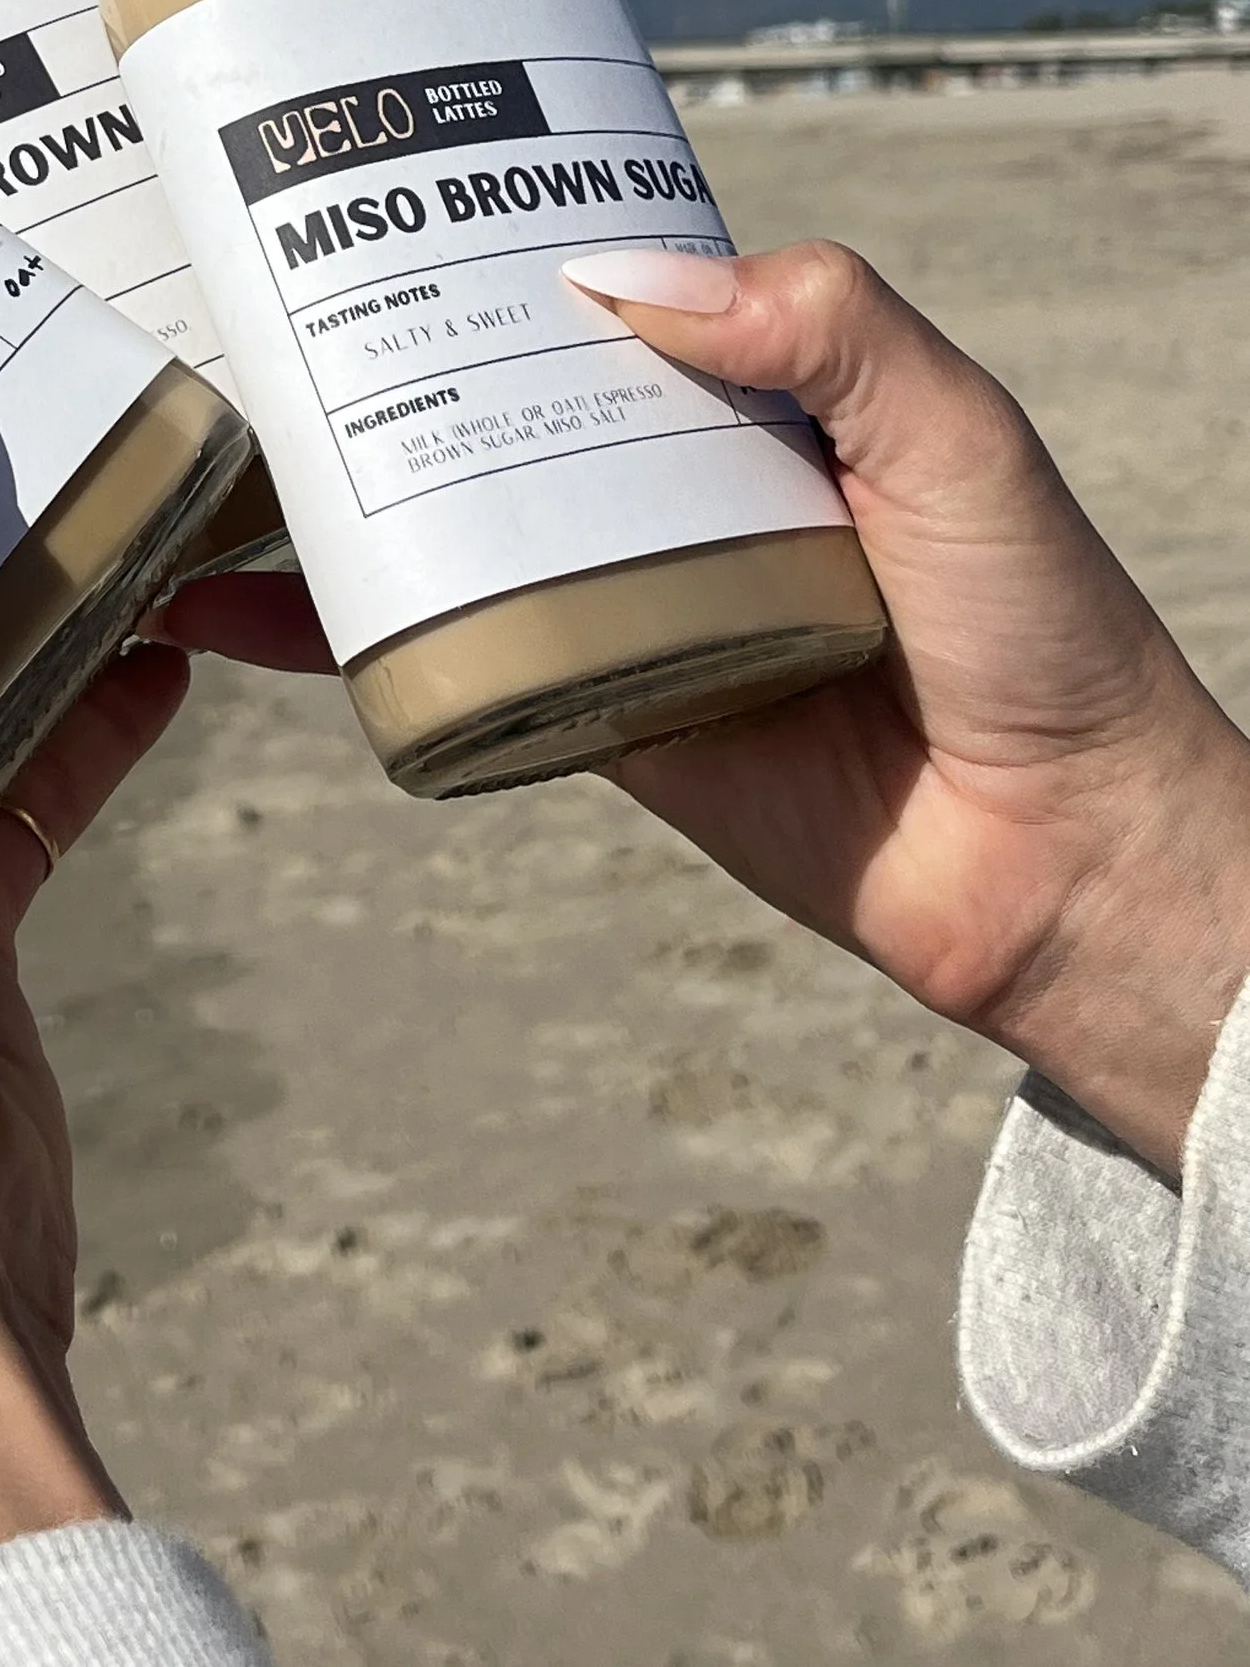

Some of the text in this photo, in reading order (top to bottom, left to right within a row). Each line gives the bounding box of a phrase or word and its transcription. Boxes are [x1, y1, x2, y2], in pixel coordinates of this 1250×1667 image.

[424, 80, 503, 104] BOTTLED
[432, 100, 498, 124] LATTES
[275, 158, 717, 270] MISO BROWN SUGA
[306, 283, 441, 338] TASTING NOTES
[364, 302, 531, 359] SALTY & SWEET
[344, 387, 460, 438] INGREDIENTS
[400, 430, 445, 453] MILK
[451, 411, 514, 441] (WHOLE
[521, 404, 546, 422] OR
[407, 440, 474, 473] BROWN
[590, 406, 626, 427] SALT
